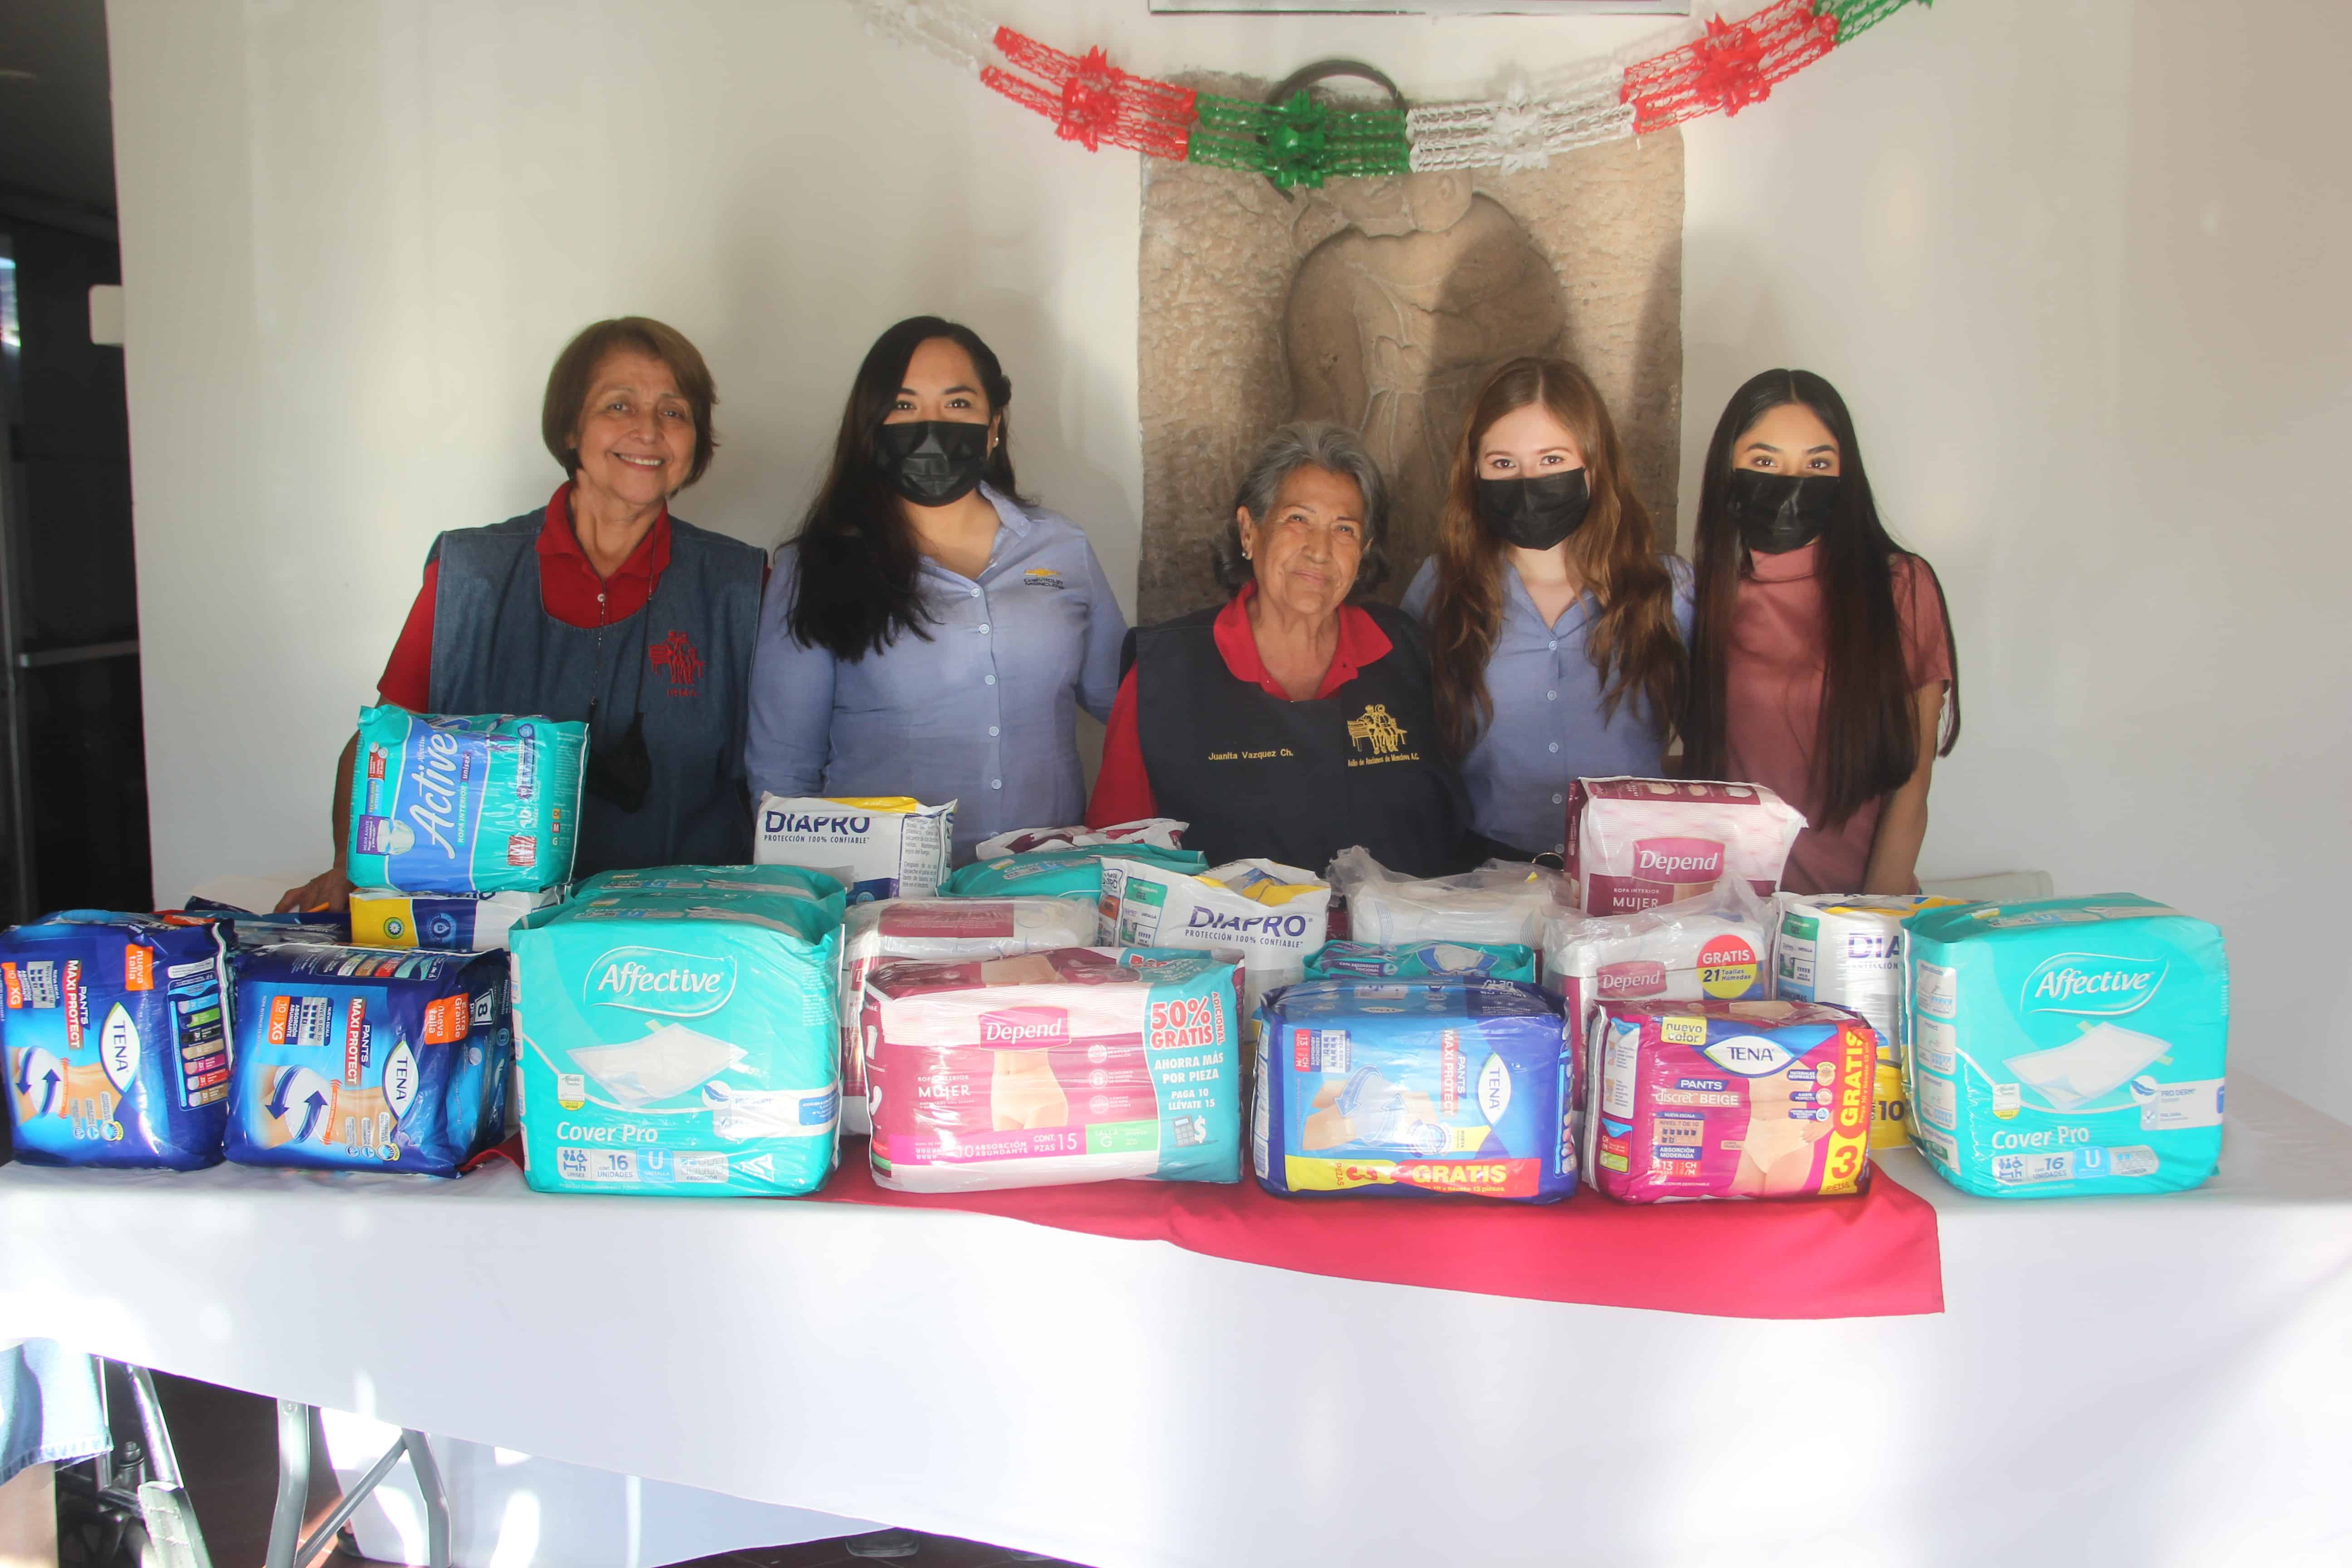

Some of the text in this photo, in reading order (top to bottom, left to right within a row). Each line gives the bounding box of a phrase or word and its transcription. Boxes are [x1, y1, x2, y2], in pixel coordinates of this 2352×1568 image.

[1208, 749, 1294, 760] Juanita Vazquez Ch.
[462, 754, 470, 779] unisex
[409, 733, 458, 859] Active
[457, 785, 468, 843] ROPA INTERIOR
[765, 810, 870, 835] DIAPRO
[764, 834, 805, 843] PROTECCIÓN
[1640, 850, 1719, 875] Depend
[1612, 897, 1659, 910] MUJER
[1188, 906, 1306, 937] DIAPRO
[1185, 929, 1232, 941] PROTECCIÓN
[1236, 935, 1256, 943] 100%
[1702, 949, 1750, 965] GRATIS
[128, 955, 137, 980] talla
[1703, 969, 1720, 982] 21
[597, 962, 722, 997] Affective
[1602, 971, 1660, 991] Depend
[2035, 970, 2151, 1001] Affective
[10, 987, 21, 1005] XG
[66, 959, 80, 1049] MAXI PROTECT
[78, 986, 89, 1025] PANTS
[279, 1003, 287, 1013] 10
[478, 1002, 488, 1017] 8
[1151, 996, 1211, 1030] 50%
[286, 1004, 294, 1038] ABUNDANTE
[428, 1006, 437, 1034] talla
[437, 1005, 446, 1037] nueva
[1211, 991, 1225, 1046] ADICIONAL
[1666, 1023, 1703, 1034] nuevo
[272, 1021, 284, 1041] XG
[348, 998, 362, 1084] MAXI PROTECT
[986, 1019, 1062, 1045] Depend
[1151, 1024, 1213, 1049] GRATIS
[1300, 1034, 1308, 1046] 13
[1667, 1032, 1700, 1043] color
[113, 1021, 127, 1071] TENA
[361, 1024, 371, 1063] PANTS
[1154, 1051, 1224, 1070] AHORRA MÁS
[1302, 1057, 1308, 1068] CH
[1727, 1047, 1773, 1061] TENA
[396, 1057, 408, 1100] TENA
[1162, 1068, 1219, 1084] POR PIEZA
[1444, 1029, 1454, 1116] MAXI PROTECT
[1457, 1056, 1466, 1094] PANTS
[1840, 1030, 1863, 1127] GRATIS
[1171, 1088, 1209, 1099] PAGA 10
[1489, 1067, 1500, 1110] TENA
[1681, 1079, 1722, 1090] PANTS
[1168, 1098, 1215, 1111] LLÉVATE 15
[1700, 1094, 1739, 1106] BEIGE
[1879, 1100, 1904, 1121] 10
[557, 1122, 659, 1143] Cover Pro
[1034, 1134, 1055, 1143] CONT.
[1058, 1133, 1078, 1151] 15
[1991, 1125, 2090, 1149] Cover Pro
[975, 1140, 1027, 1152] ABSORCIÓN
[975, 1147, 1029, 1157] ABUNDANTE
[1034, 1144, 1055, 1152] PZAS
[608, 1154, 629, 1171] 16
[648, 1150, 663, 1170] U
[1662, 1161, 1673, 1171] 13
[1831, 1145, 1858, 1179] 3
[2044, 1157, 2064, 1171] 16
[2085, 1149, 2101, 1168] U
[597, 1170, 633, 1179] UNIDADES
[1335, 1162, 1344, 1186] PIEZAS
[1412, 1164, 1506, 1184] GRATIS
[2033, 1170, 2067, 1179] UNIDADES
[1826, 1181, 1850, 1191] PIEZAS
